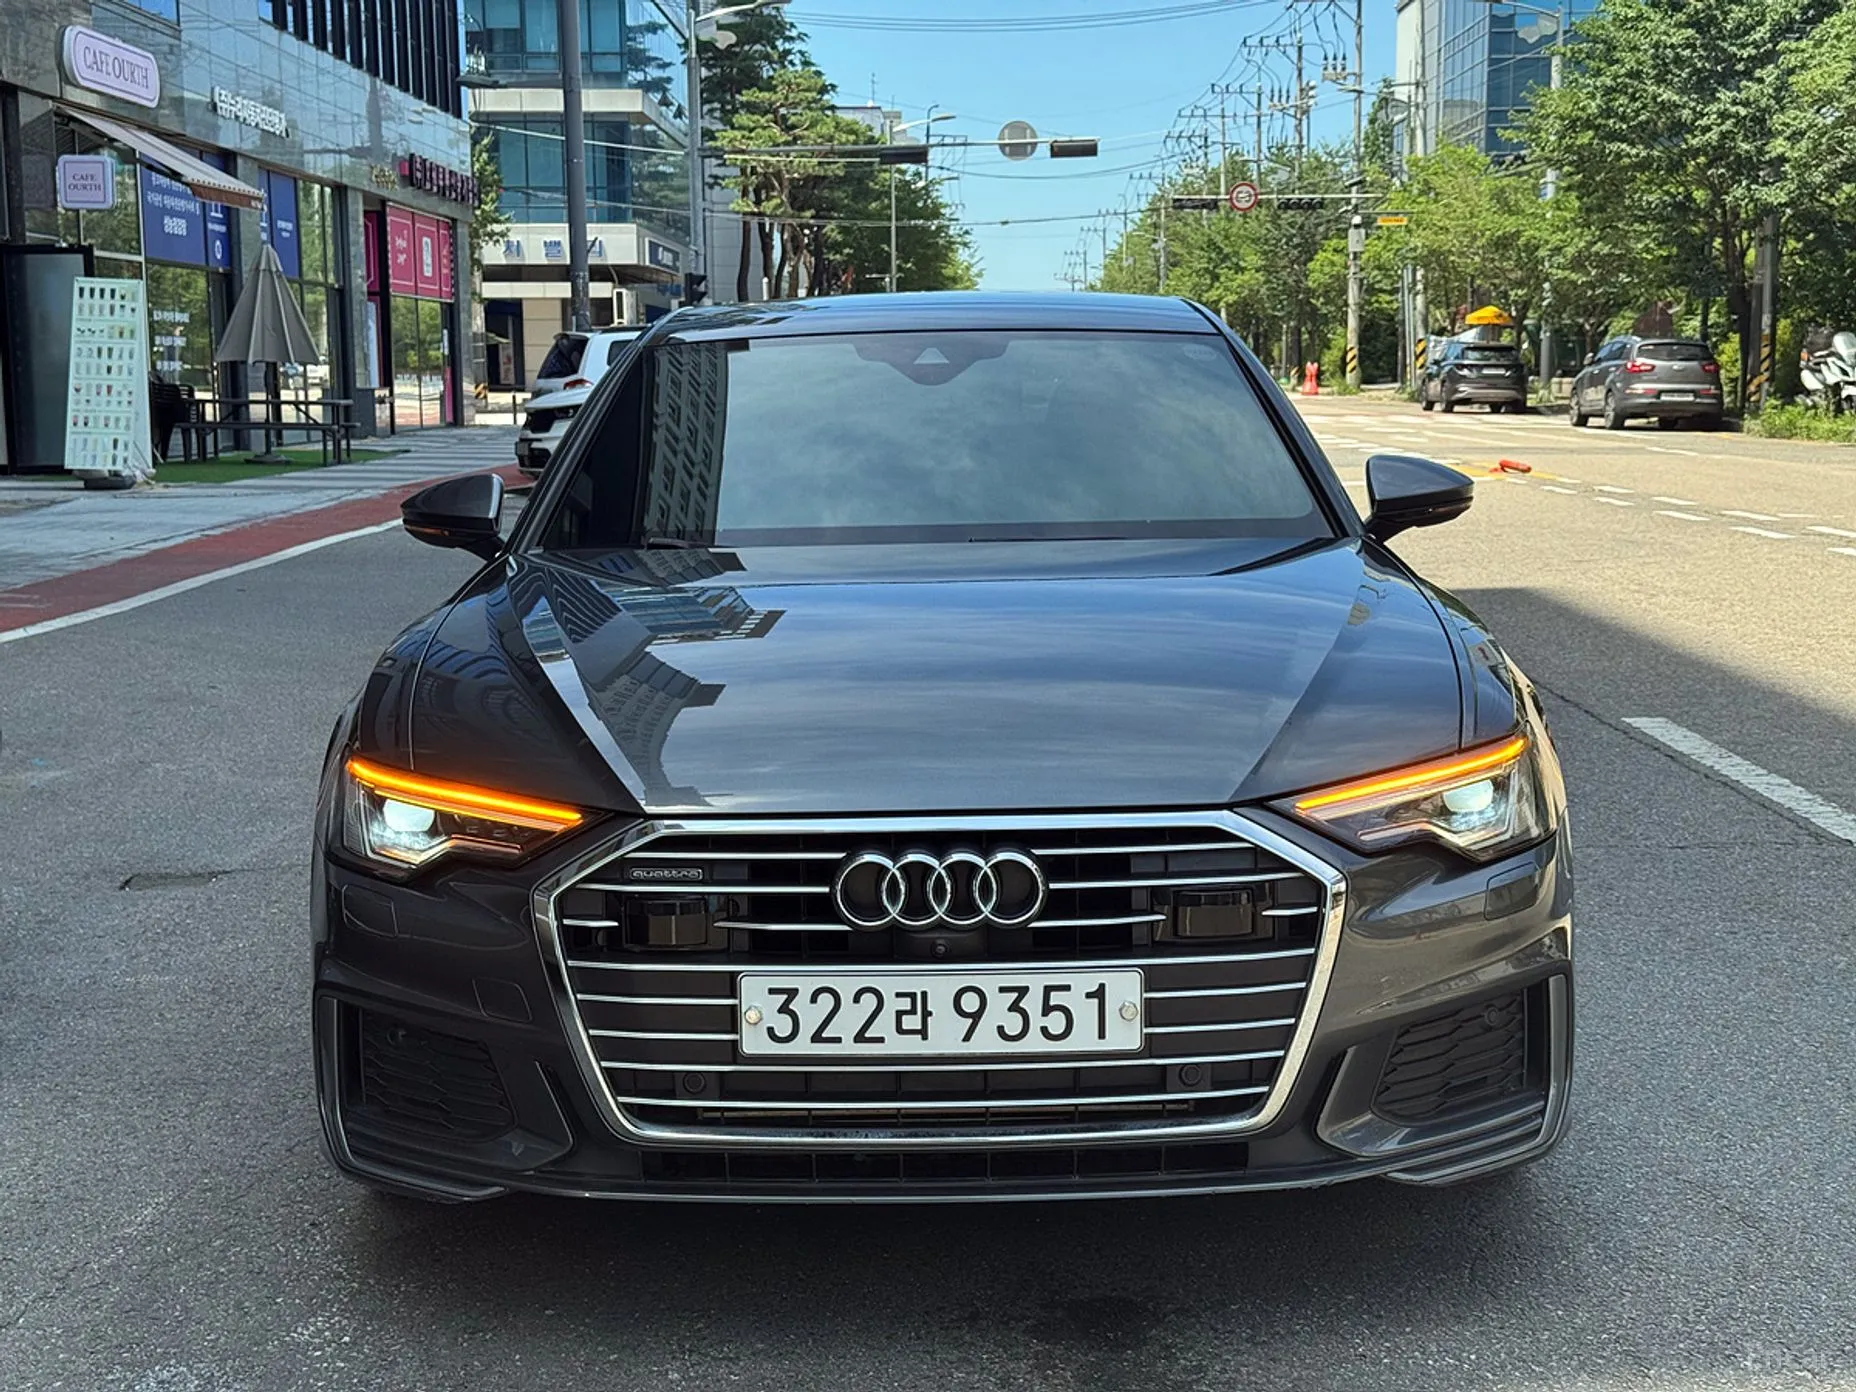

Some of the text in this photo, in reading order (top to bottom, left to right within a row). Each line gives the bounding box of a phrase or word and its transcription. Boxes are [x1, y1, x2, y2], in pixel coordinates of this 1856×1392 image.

[83, 46, 149, 89] CAFE OURTH
[72, 173, 96, 181] CAFE
[632, 870, 699, 879] quattro
[766, 983, 1107, 1044] 322라 9351
